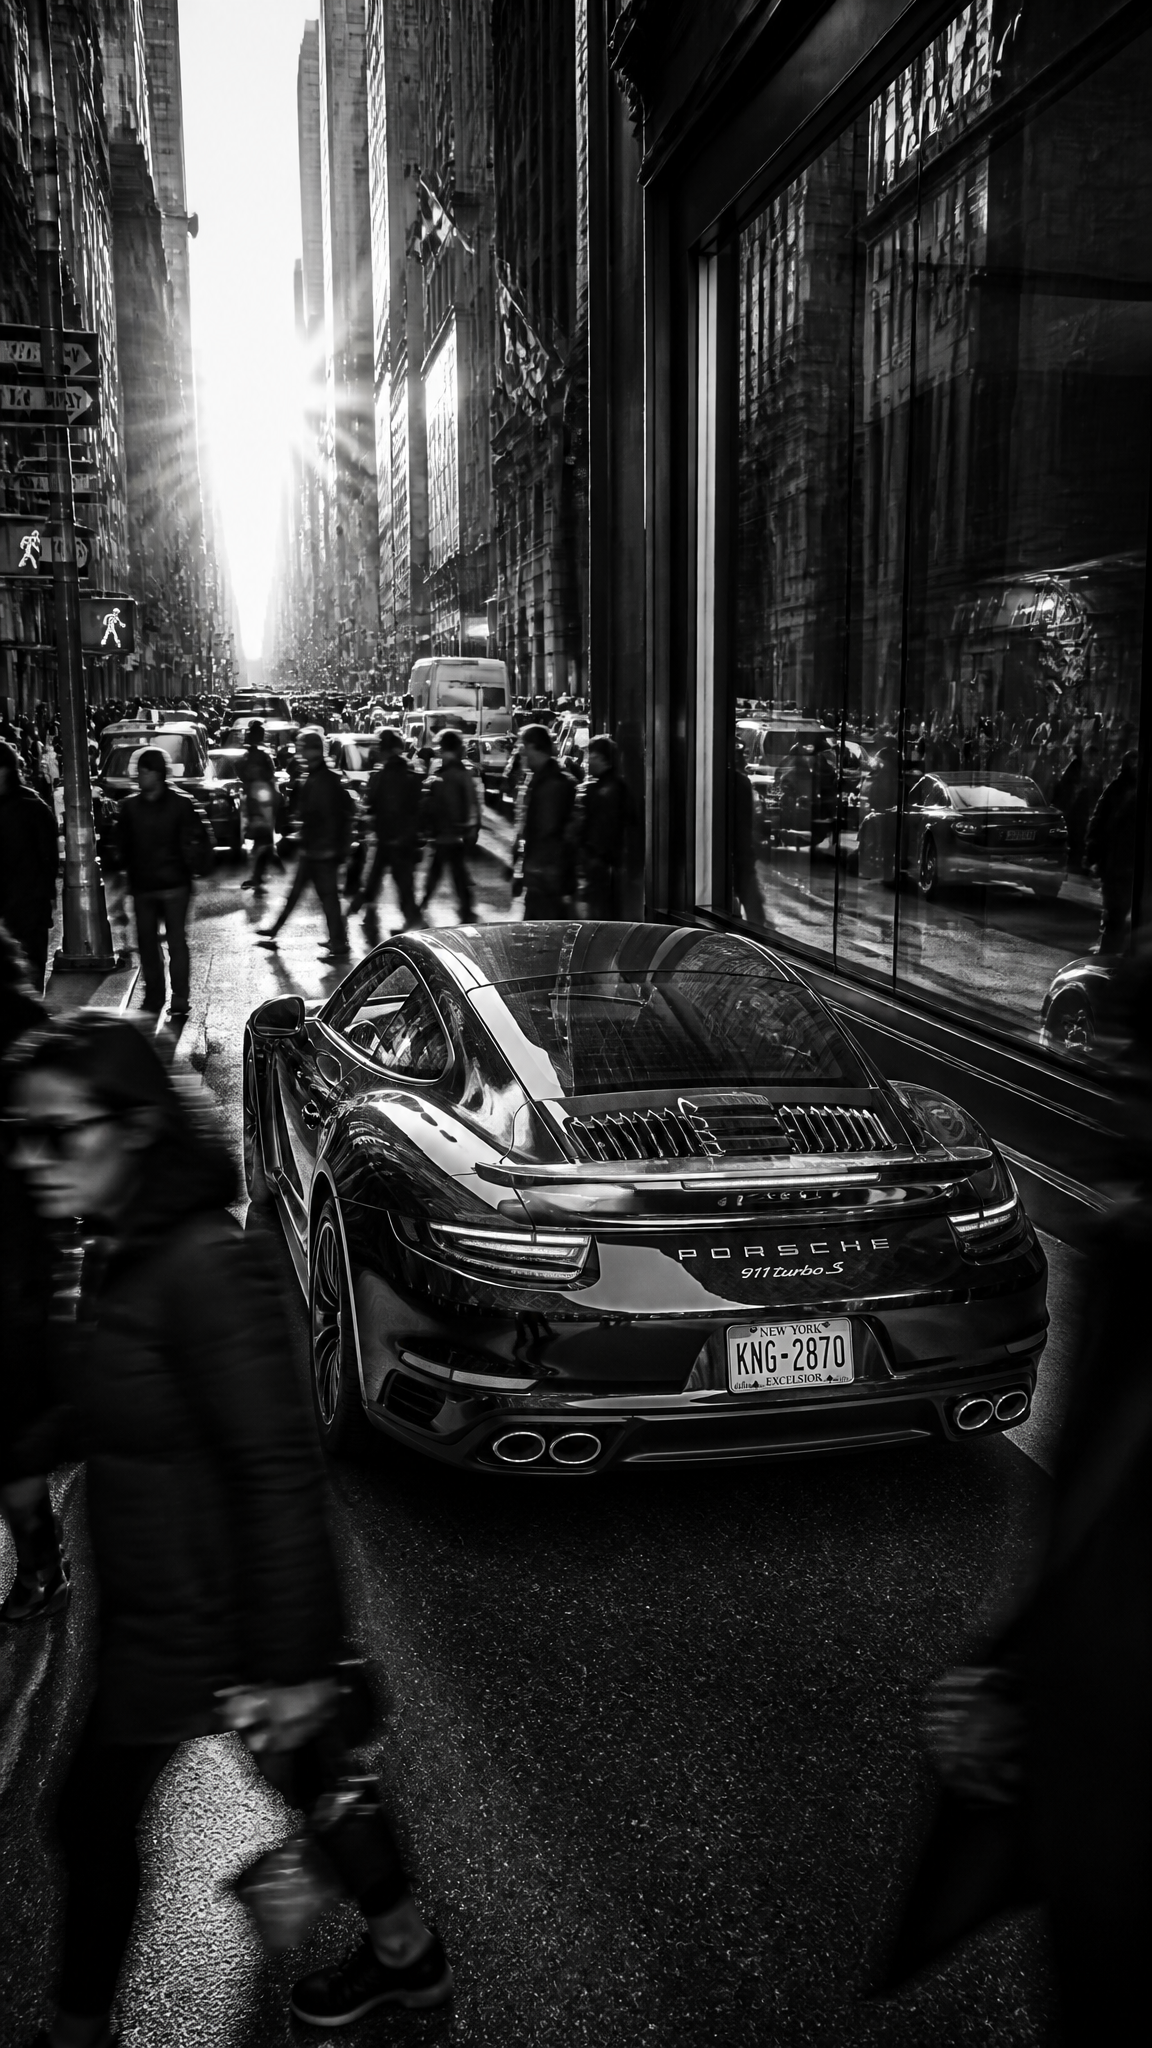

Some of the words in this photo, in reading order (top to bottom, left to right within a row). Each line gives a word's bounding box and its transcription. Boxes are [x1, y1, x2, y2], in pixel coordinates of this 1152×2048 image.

[678, 1238, 890, 1261] PORSCHE
[741, 1266, 772, 1279] 911
[772, 1265, 824, 1278] turbo
[825, 1261, 845, 1275] S
[760, 1326, 787, 1338] NEW
[791, 1323, 822, 1335] YORK
[736, 1335, 846, 1375] KNG-2870
[766, 1373, 823, 1386] EXCELSIOR
